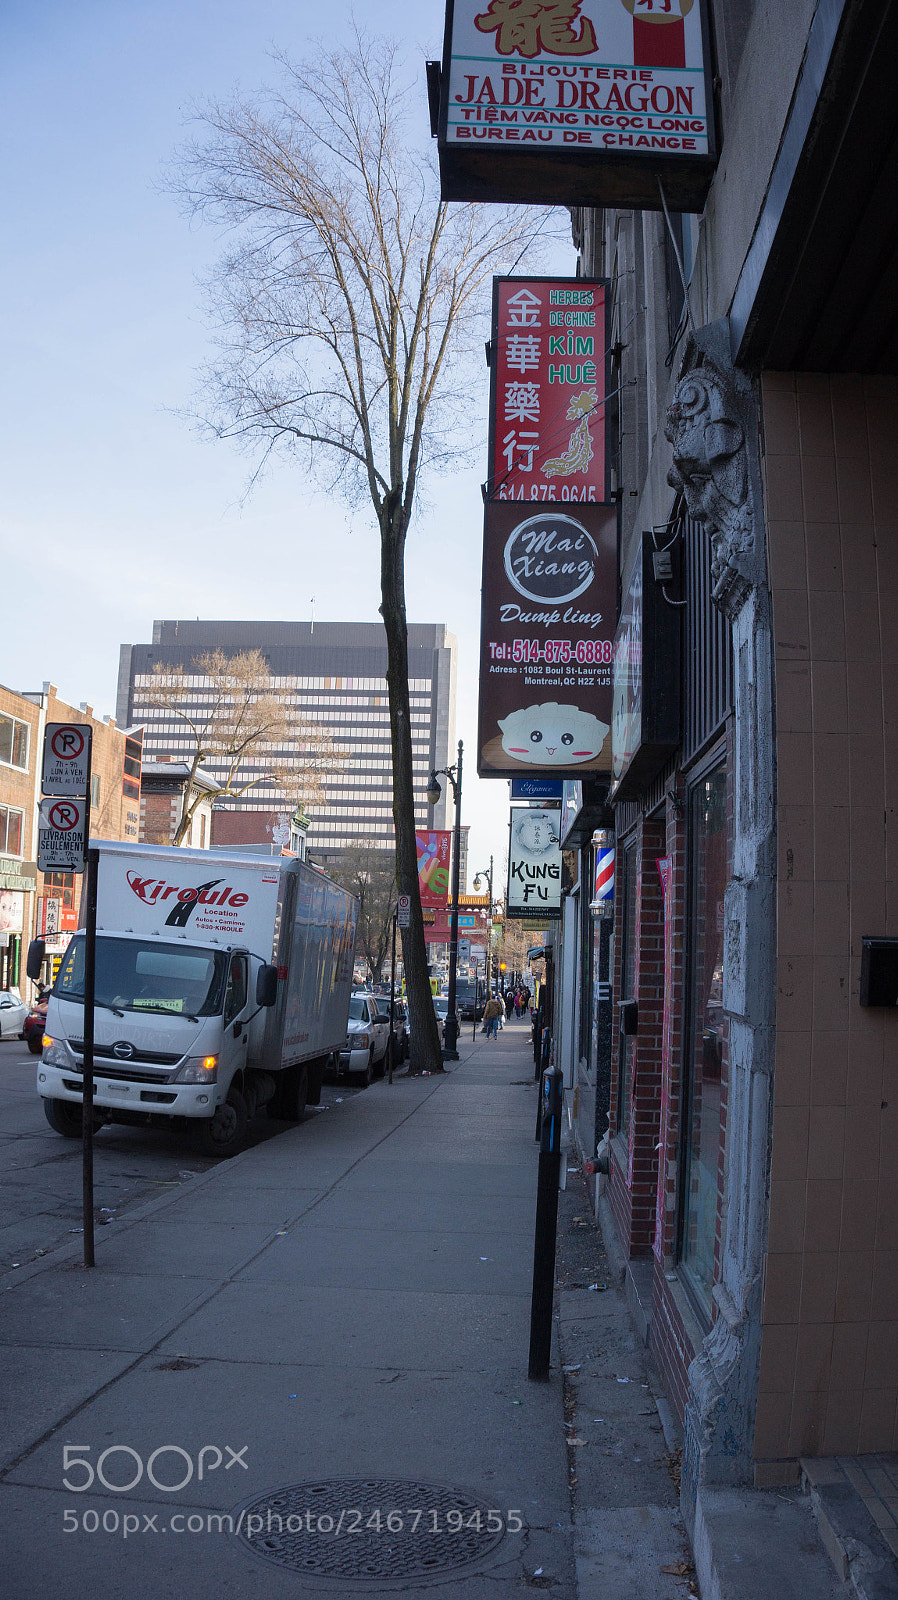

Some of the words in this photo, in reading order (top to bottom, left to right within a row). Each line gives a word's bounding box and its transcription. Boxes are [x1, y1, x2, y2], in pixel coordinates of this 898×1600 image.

[502, 63, 654, 82] BIJOUTERIE
[455, 75, 546, 107] JADE
[555, 80, 695, 115] DRAGON
[521, 108, 579, 124] VÀNG
[584, 113, 644, 131] NGỌC
[648, 118, 705, 132] LONG
[455, 127, 553, 142] BUREAU
[563, 131, 593, 144] DE
[602, 133, 697, 150] CHANGE
[550, 290, 594, 305] HERBES
[550, 311, 563, 326] DE
[565, 311, 596, 327] CHINE
[502, 288, 542, 472] 金華藥行
[548, 359, 597, 384] HUÊ
[521, 530, 585, 554] Mai
[512, 555, 594, 580] Xiang
[500, 603, 603, 629] Dumpling
[512, 639, 613, 663] 514-875-6888
[489, 665, 518, 674] Adress
[545, 666, 564, 674] Boul
[565, 667, 611, 675] St-Laurent
[578, 677, 594, 686] H2Z
[597, 677, 611, 686] 1J5
[48, 776, 63, 784] AVRIL
[40, 841, 84, 852] SEULEMENT
[43, 831, 83, 842] LIVRAISON
[511, 860, 560, 882] KUNG
[130, 877, 249, 908] Kiroule
[522, 883, 548, 903] FU
[204, 908, 238, 918] Location
[218, 918, 246, 926] Camions
